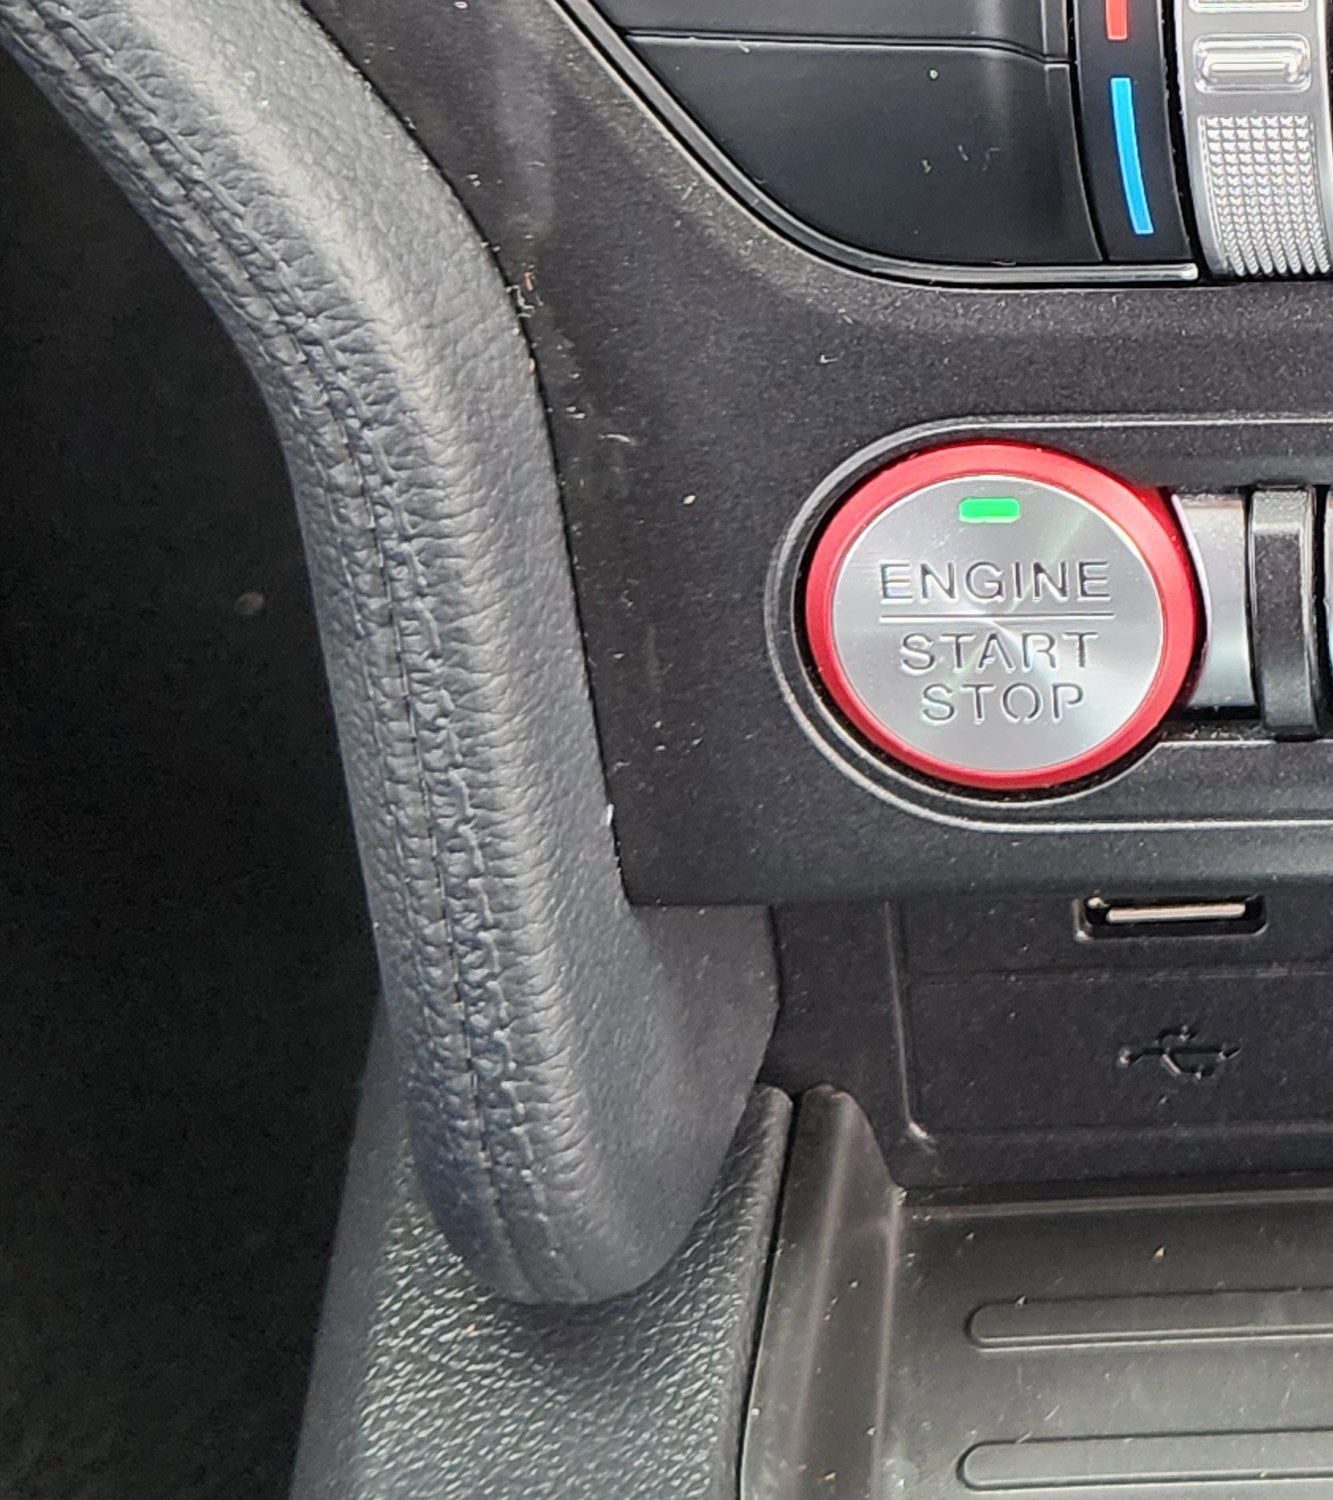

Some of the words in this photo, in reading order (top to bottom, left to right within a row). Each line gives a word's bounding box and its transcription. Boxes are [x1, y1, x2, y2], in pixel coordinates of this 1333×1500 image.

[878, 559, 1113, 601] ENGINE
[900, 631, 1097, 673] START
[920, 682, 1085, 724] STOP
